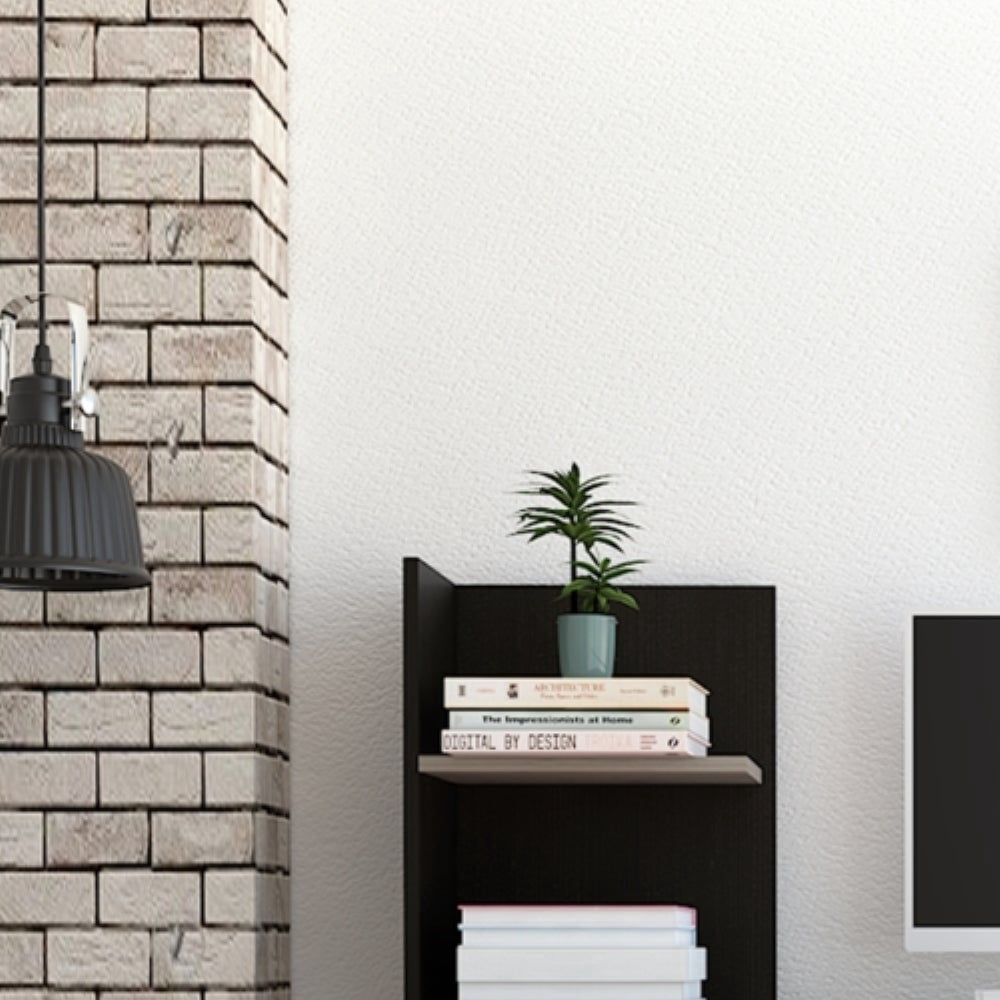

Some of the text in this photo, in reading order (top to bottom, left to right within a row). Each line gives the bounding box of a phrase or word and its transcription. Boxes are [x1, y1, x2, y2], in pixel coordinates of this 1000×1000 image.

[482, 715, 634, 727] The Impressionists at Home
[443, 733, 497, 751] DIGITAL
[504, 733, 520, 751] BY
[528, 733, 577, 751] DESIGN
